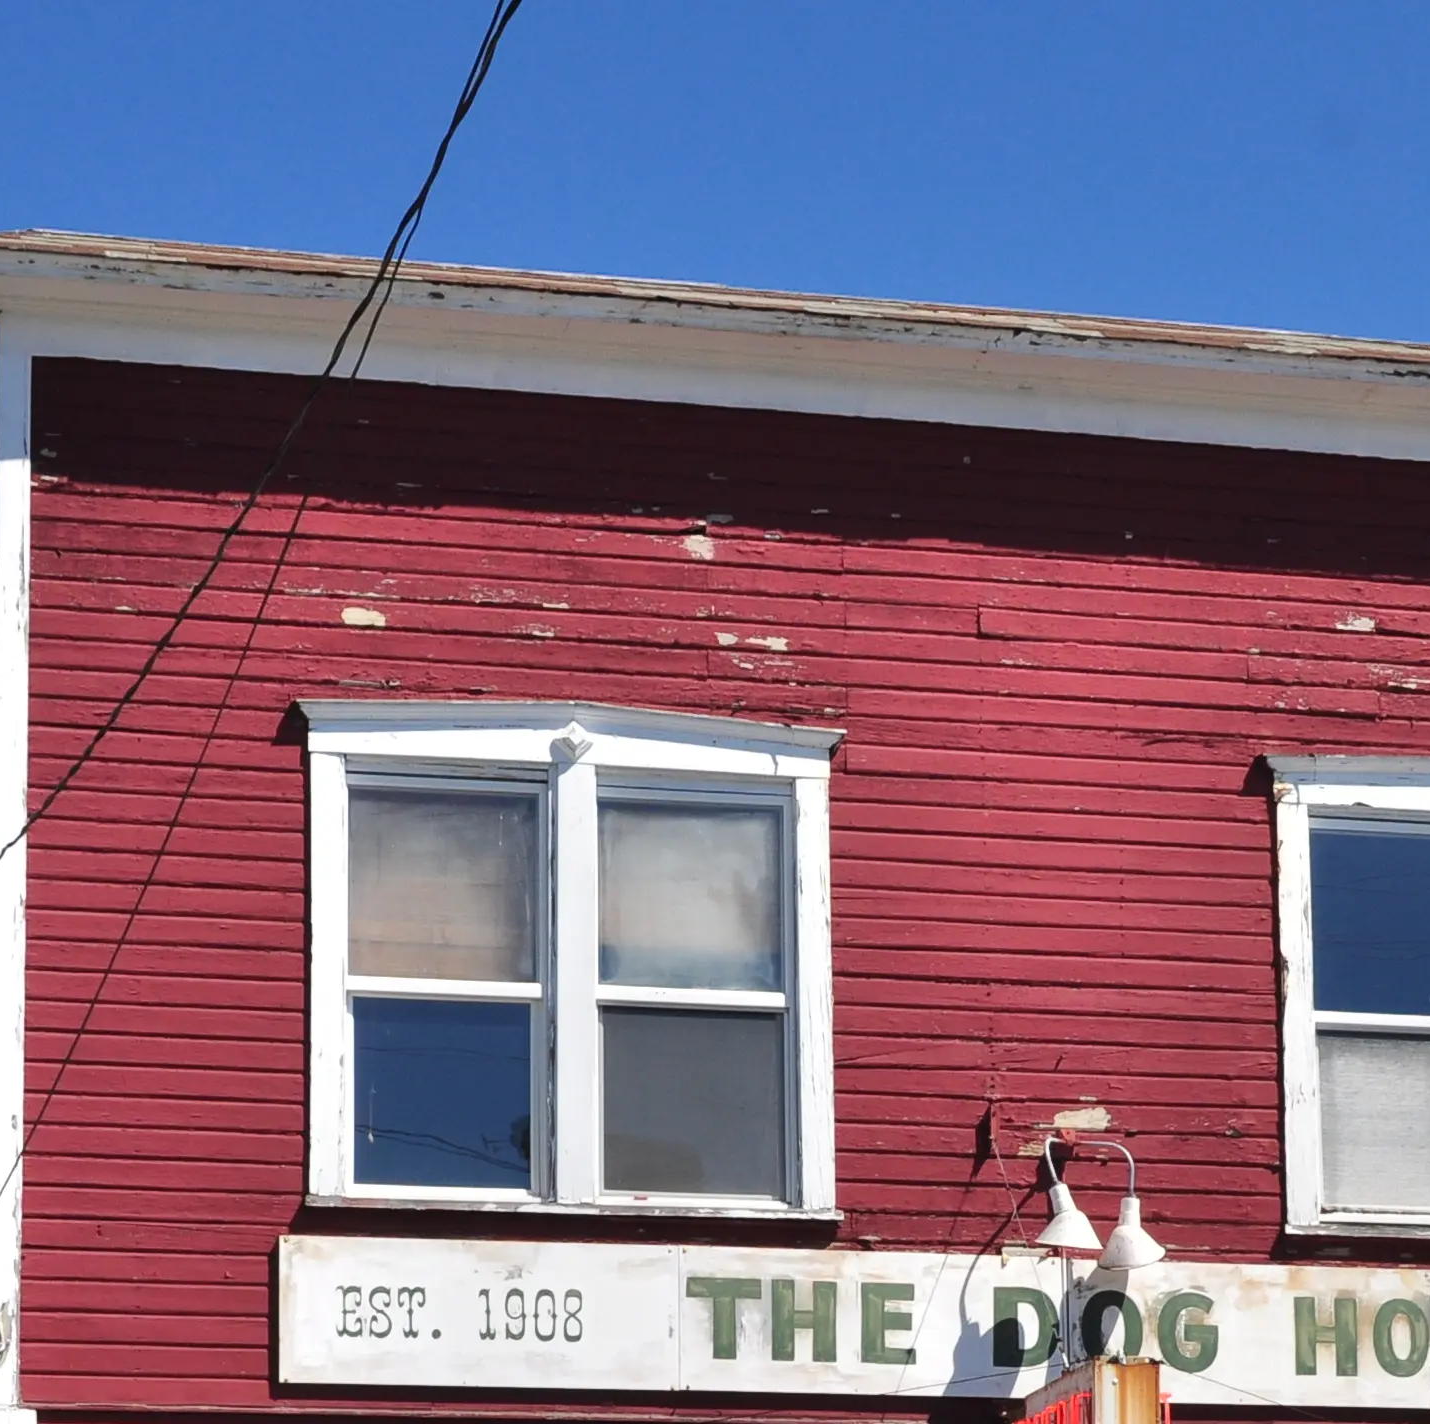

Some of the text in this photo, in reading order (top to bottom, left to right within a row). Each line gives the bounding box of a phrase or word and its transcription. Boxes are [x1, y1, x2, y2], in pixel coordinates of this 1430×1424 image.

[334, 1284, 584, 1343] EST. 1908
[685, 1276, 917, 1366] THE
[991, 1285, 1220, 1375] DOG
